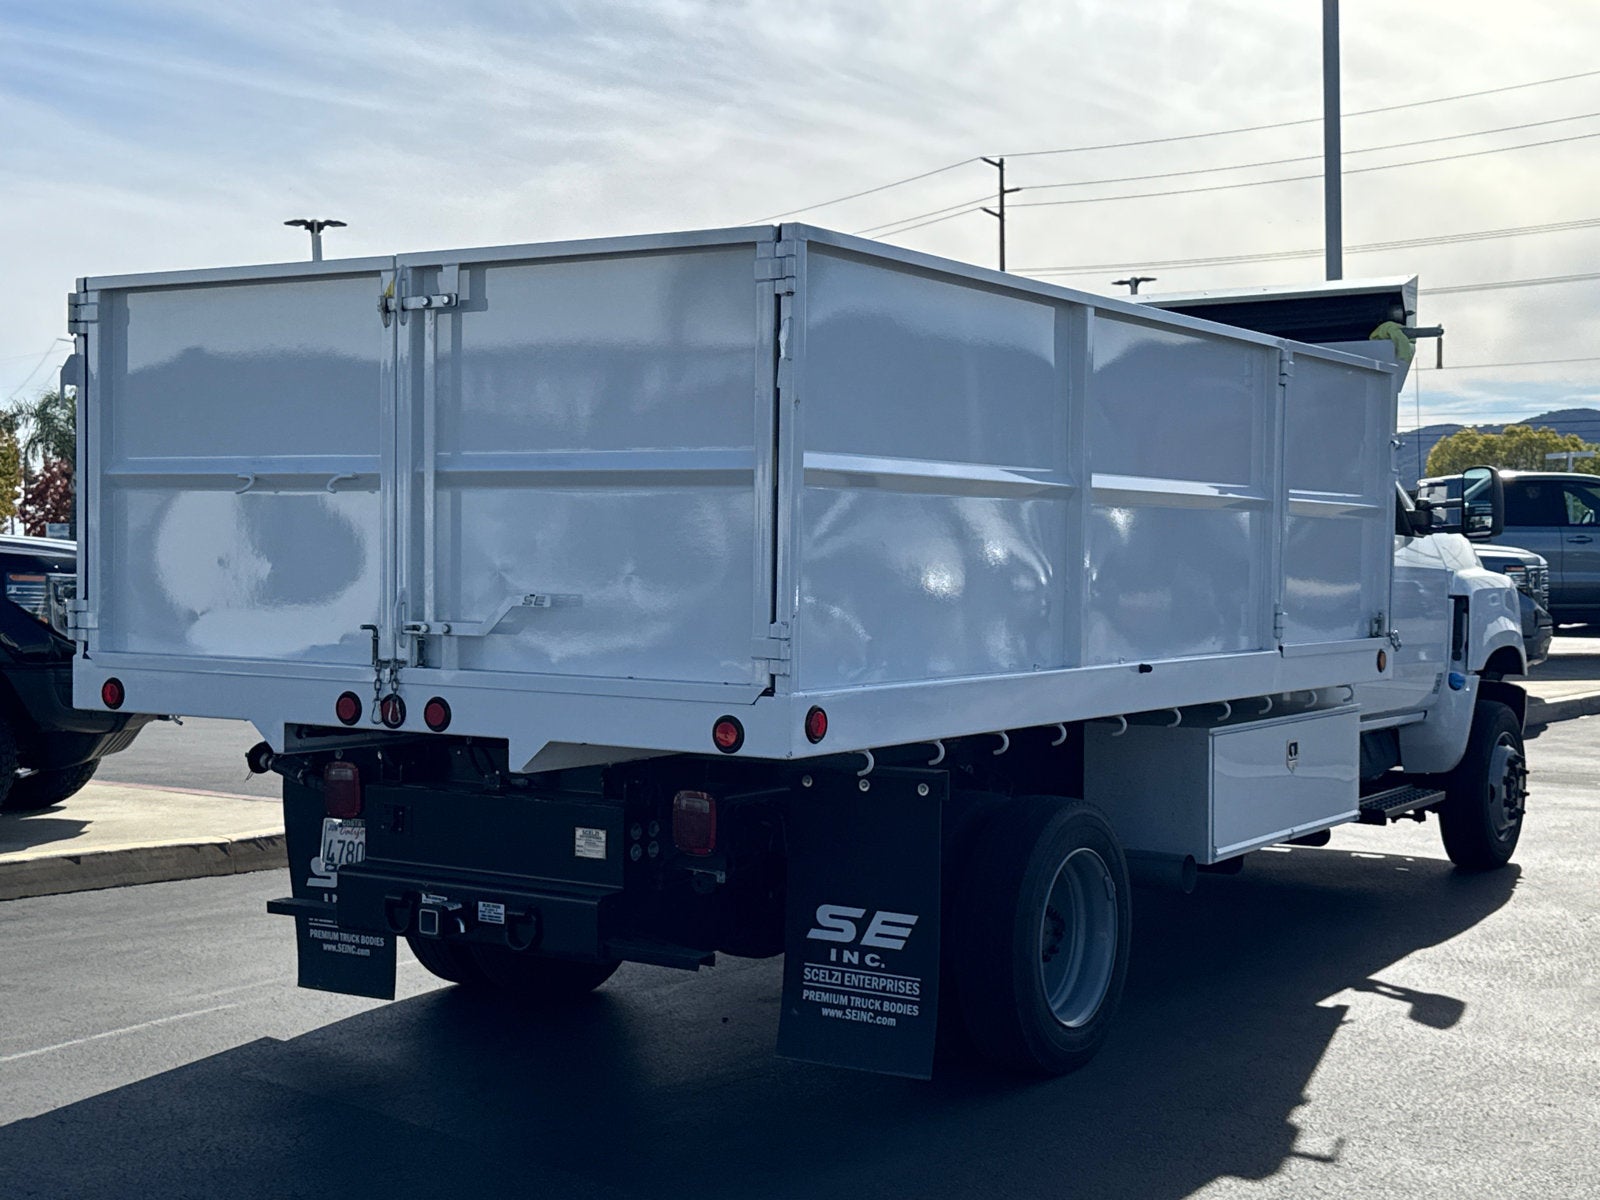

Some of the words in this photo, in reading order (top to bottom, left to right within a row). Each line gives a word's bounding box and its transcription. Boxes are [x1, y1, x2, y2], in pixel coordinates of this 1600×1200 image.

[309, 928, 339, 941] PREMIUM
[340, 932, 360, 944] TRUCK
[361, 936, 385, 947] BODIES
[806, 904, 919, 950] SE
[322, 943, 371, 957] www.SEINC.com
[830, 948, 886, 968] INC.
[803, 967, 842, 984] SCELZI
[844, 972, 920, 995] ENTERPRISES
[802, 989, 848, 1006] PREMIUM
[850, 996, 882, 1012] TRUCK
[882, 1001, 920, 1016] BODIES
[821, 1006, 897, 1027] www.SEINC.com
